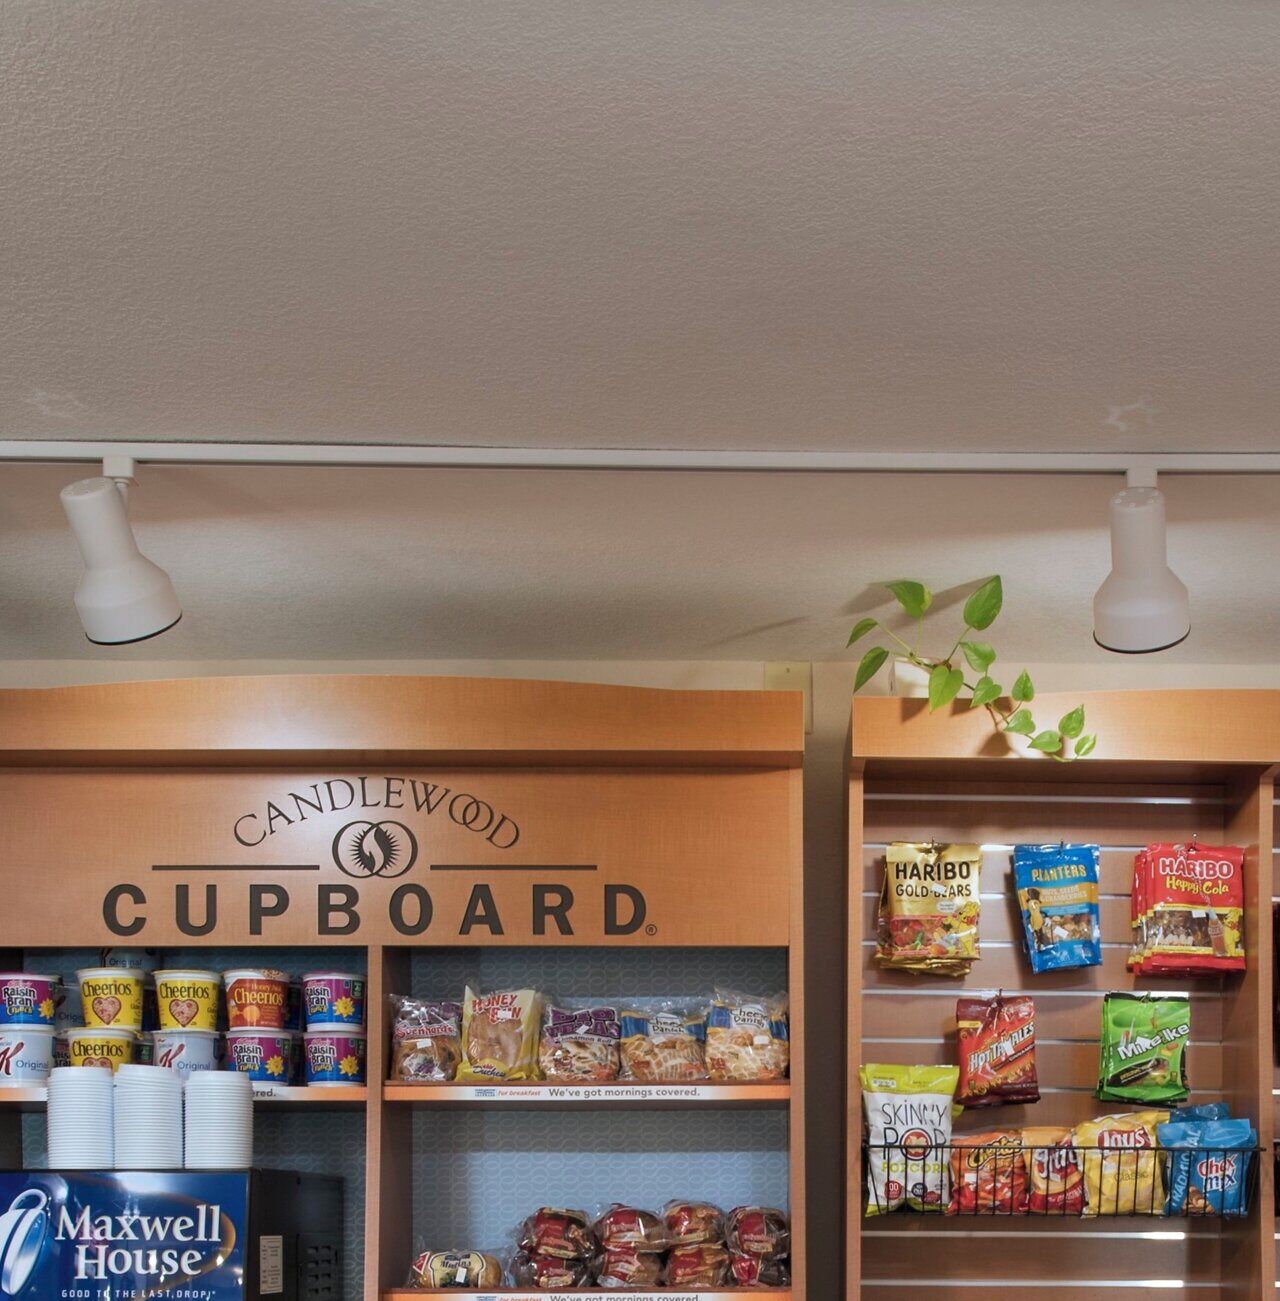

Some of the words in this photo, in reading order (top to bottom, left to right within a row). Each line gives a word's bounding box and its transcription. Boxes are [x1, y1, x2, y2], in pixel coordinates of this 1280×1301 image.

[233, 776, 520, 850] CANDLEWOOD
[895, 861, 971, 881] HARIBO
[1031, 865, 1087, 882] PLANTERS
[1159, 857, 1234, 879] HARIBO
[1165, 875, 1201, 894] Happy
[1202, 880, 1230, 894] Cola
[102, 883, 648, 937] CUPBOARD
[3, 987, 37, 998] Raisin
[82, 981, 132, 997] Cheerios
[160, 982, 210, 999] Cheerios
[234, 988, 284, 1005] Cheerios
[7, 997, 33, 1008] Bran
[72, 1041, 124, 1057] Cheerios
[233, 1045, 263, 1057] Raisin
[308, 1045, 337, 1057] Raisin
[16, 1059, 50, 1071] Original
[177, 1060, 211, 1071] Original
[548, 1088, 581, 1097] We've
[583, 1089, 602, 1099] got
[605, 1088, 653, 1099] mornings
[655, 1088, 700, 1097] covered.
[55, 1204, 222, 1243] Maxwell
[74, 1244, 203, 1280] House
[61, 1289, 91, 1298] GOOD
[114, 1289, 137, 1298] THE
